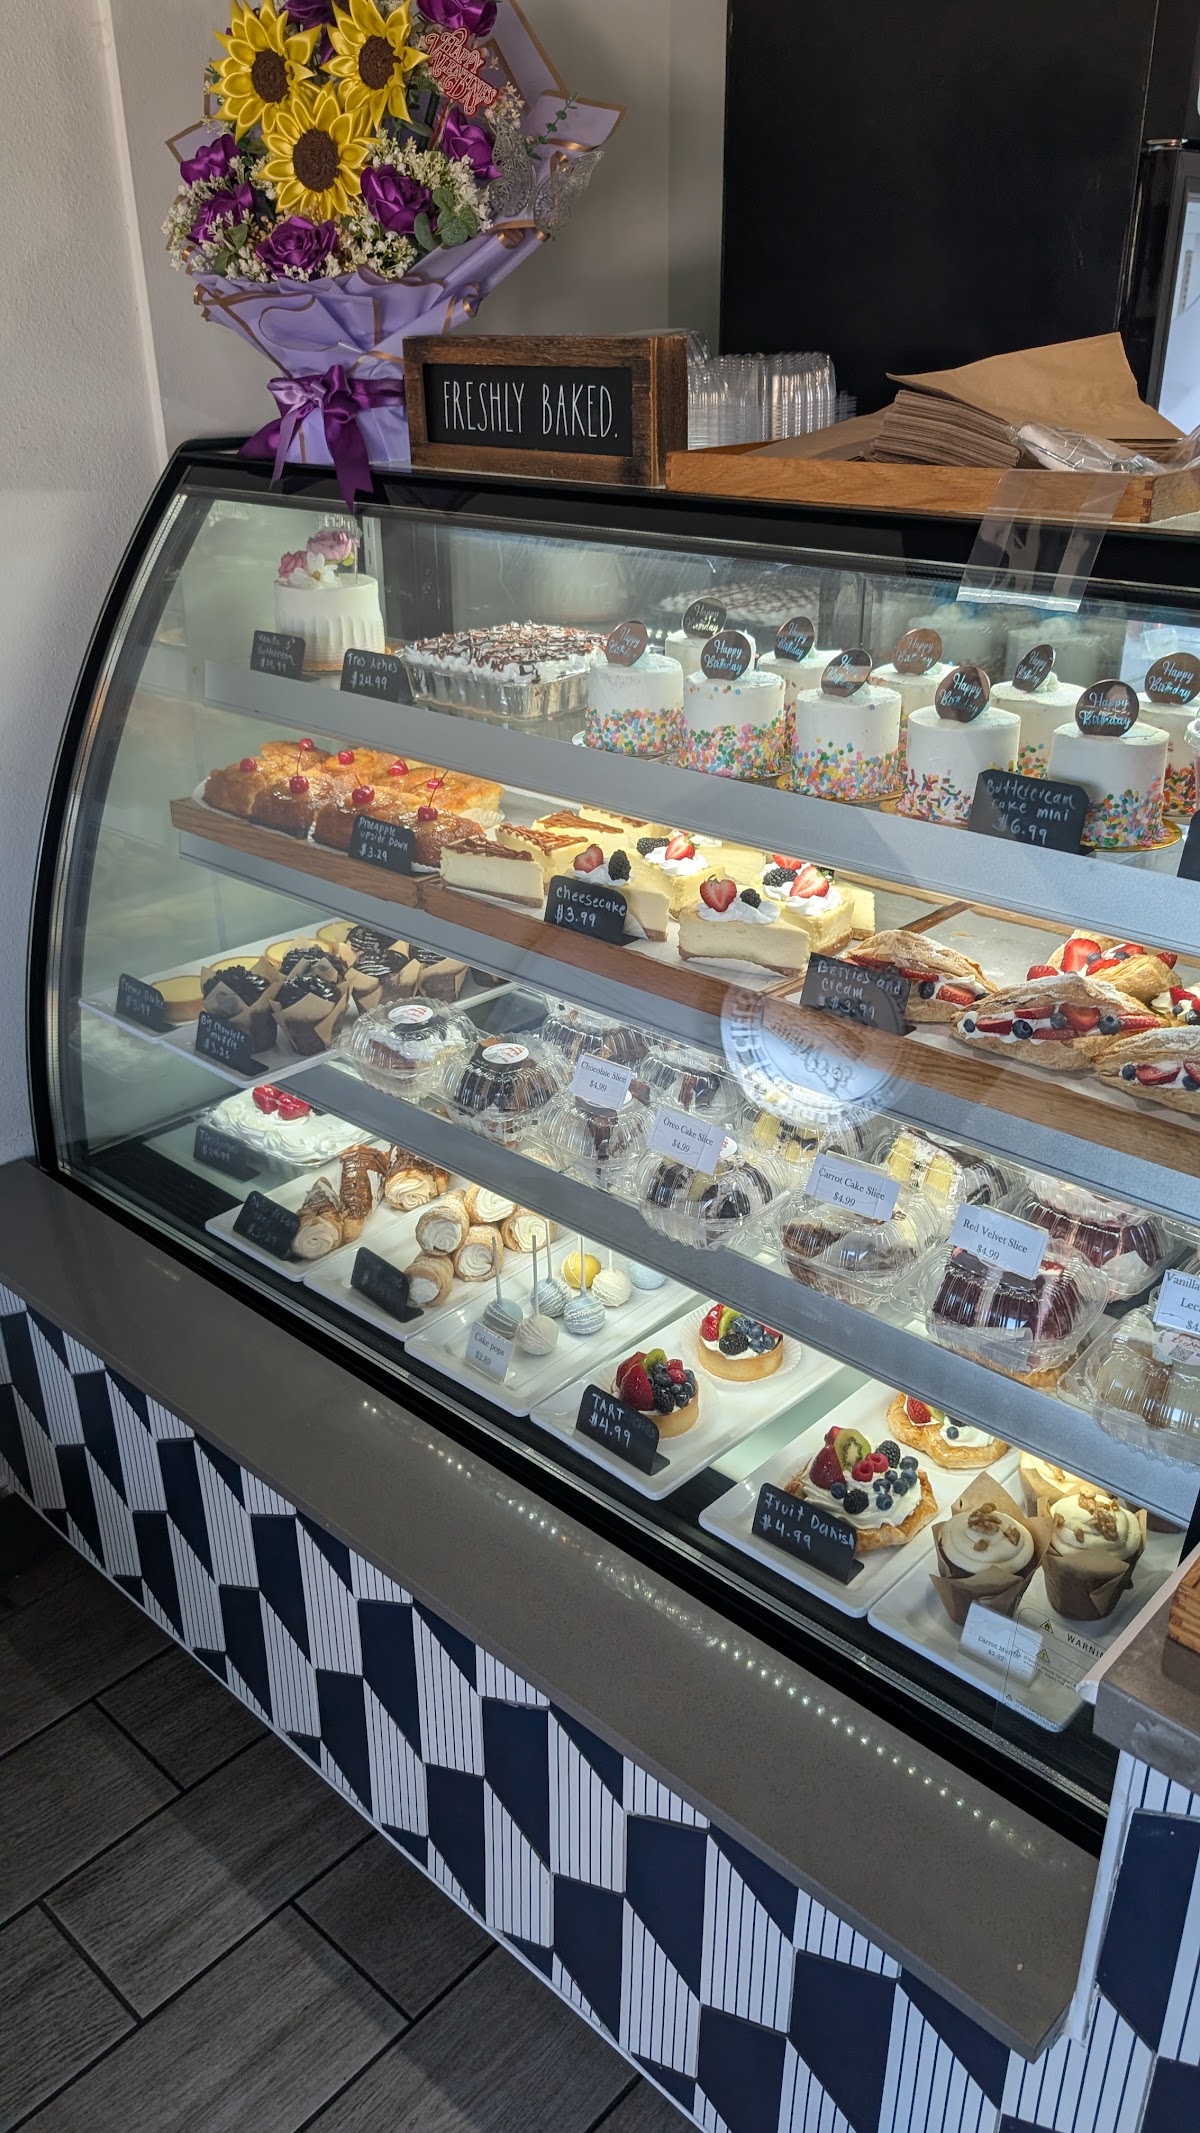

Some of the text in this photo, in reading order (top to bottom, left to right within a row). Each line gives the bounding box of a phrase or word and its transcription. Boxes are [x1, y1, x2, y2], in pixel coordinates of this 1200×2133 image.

[440, 27, 484, 75] HAPPY
[443, 75, 484, 115] DAY
[443, 381, 618, 438] FRESHLY BAKED.
[789, 621, 807, 644] Happy
[714, 640, 742, 659] Happy
[908, 637, 934, 654] Happy
[348, 652, 366, 668] Tres
[704, 655, 742, 675] Birthday
[1029, 650, 1047, 671] Happy
[350, 671, 387, 691] $24.99
[1162, 661, 1194, 684] Happy
[953, 672, 982, 699] Happy
[1148, 675, 1191, 702] Birthday
[1089, 692, 1129, 711] Happy
[1079, 710, 1131, 730] Birthday
[987, 779, 1076, 809] Buttercream
[992, 813, 1048, 845] $6.99
[358, 843, 388, 862] $3.29
[556, 885, 626, 916] cheesecake
[555, 904, 596, 927] $3.99
[818, 960, 901, 995] Berries and
[830, 996, 876, 1019] $3.99
[201, 1015, 212, 1032] Big
[203, 1038, 230, 1060] $3.25
[581, 1061, 627, 1084] Chocolate Slice
[589, 1080, 608, 1092] $4.99
[663, 1117, 680, 1131] Oreo
[680, 1125, 697, 1139] Cake
[698, 1131, 714, 1146] Slice
[671, 1139, 691, 1153] $4.99
[818, 1167, 886, 1201] Carrot Cake Slice
[833, 1191, 856, 1207] $4.99
[963, 1218, 1028, 1254] Red Velvet Slice
[976, 1244, 1000, 1261] $4.99
[1167, 1272, 1200, 1291] Vanilla
[1180, 1297, 1200, 1312] Lec
[474, 1332, 505, 1357] Cake pops
[475, 1351, 492, 1366] $2.89
[592, 1392, 625, 1420] TART
[588, 1411, 631, 1448] $4.99
[760, 1513, 811, 1550] $4.99
[765, 1492, 855, 1550] Fruit Danish
[978, 1636, 998, 1649] Carrot
[988, 1649, 1005, 1661] $2.99
